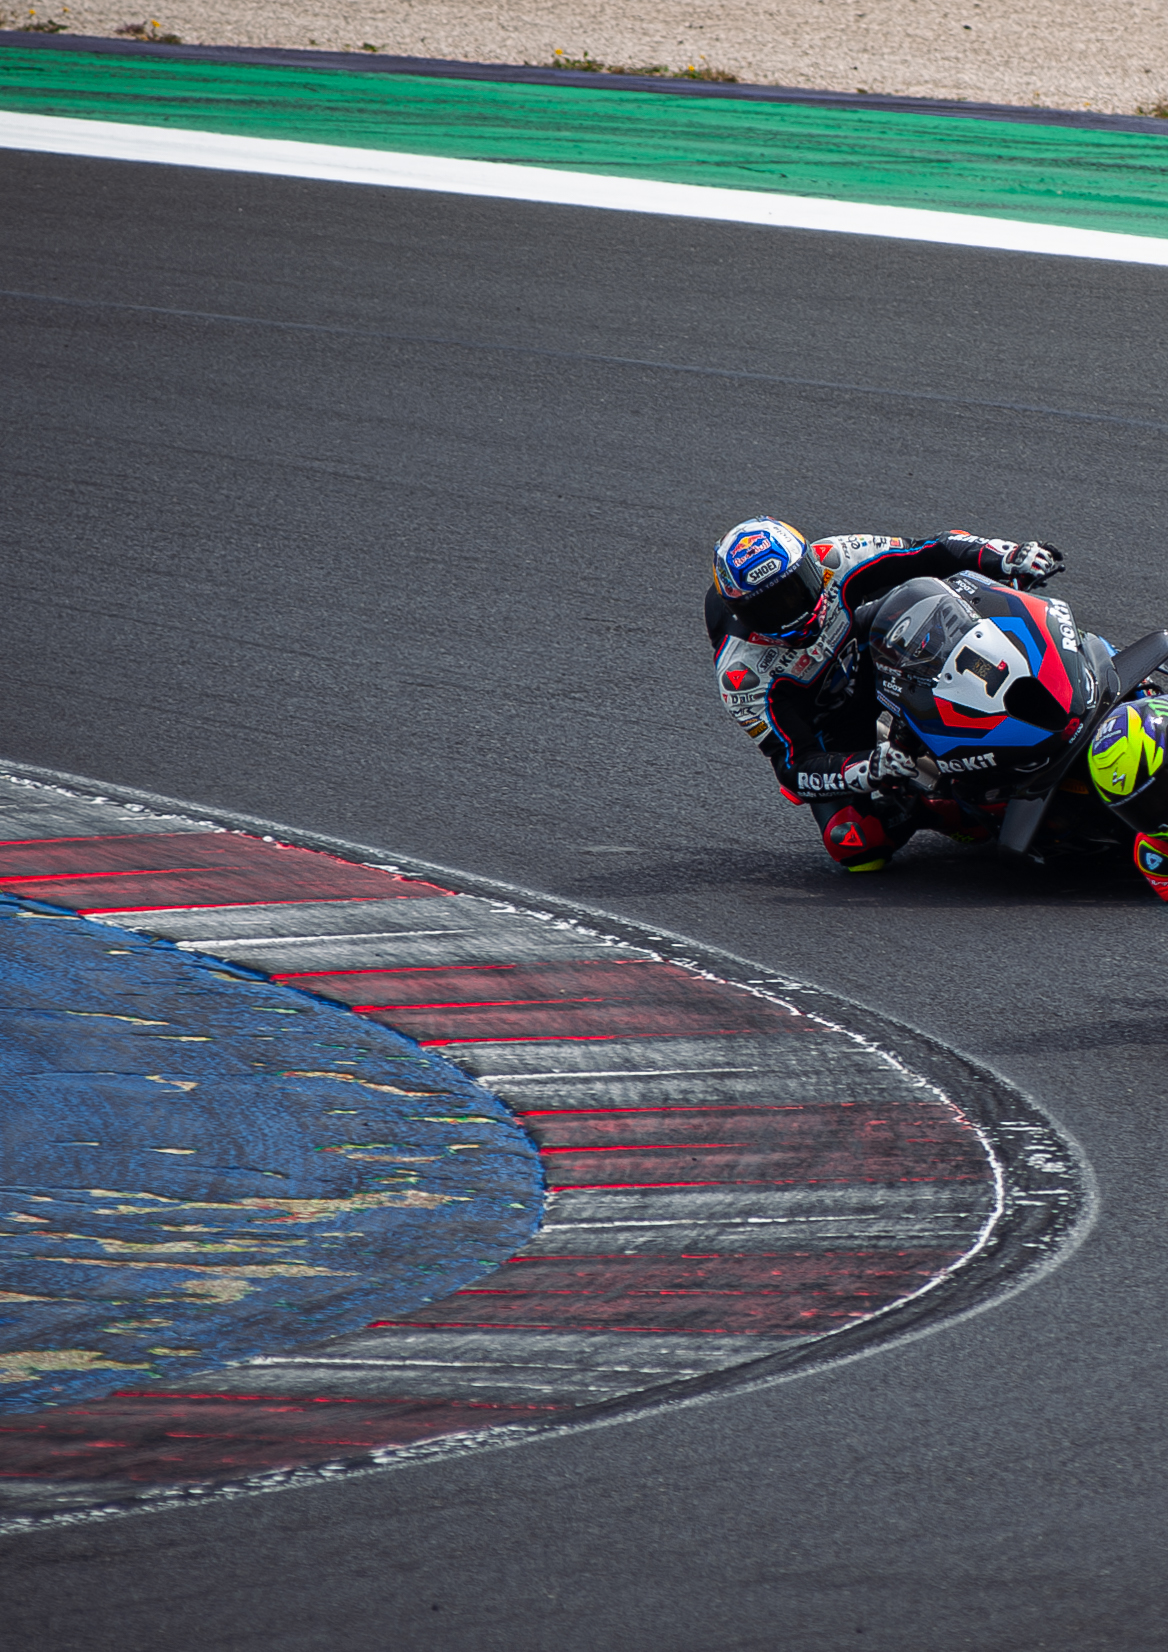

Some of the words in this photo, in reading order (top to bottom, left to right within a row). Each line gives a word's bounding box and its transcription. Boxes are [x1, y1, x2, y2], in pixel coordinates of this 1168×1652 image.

[748, 561, 777, 582] SHOEI
[955, 645, 1010, 698] 1
[937, 752, 997, 773] ROKiT
[798, 772, 844, 791] ROKi
